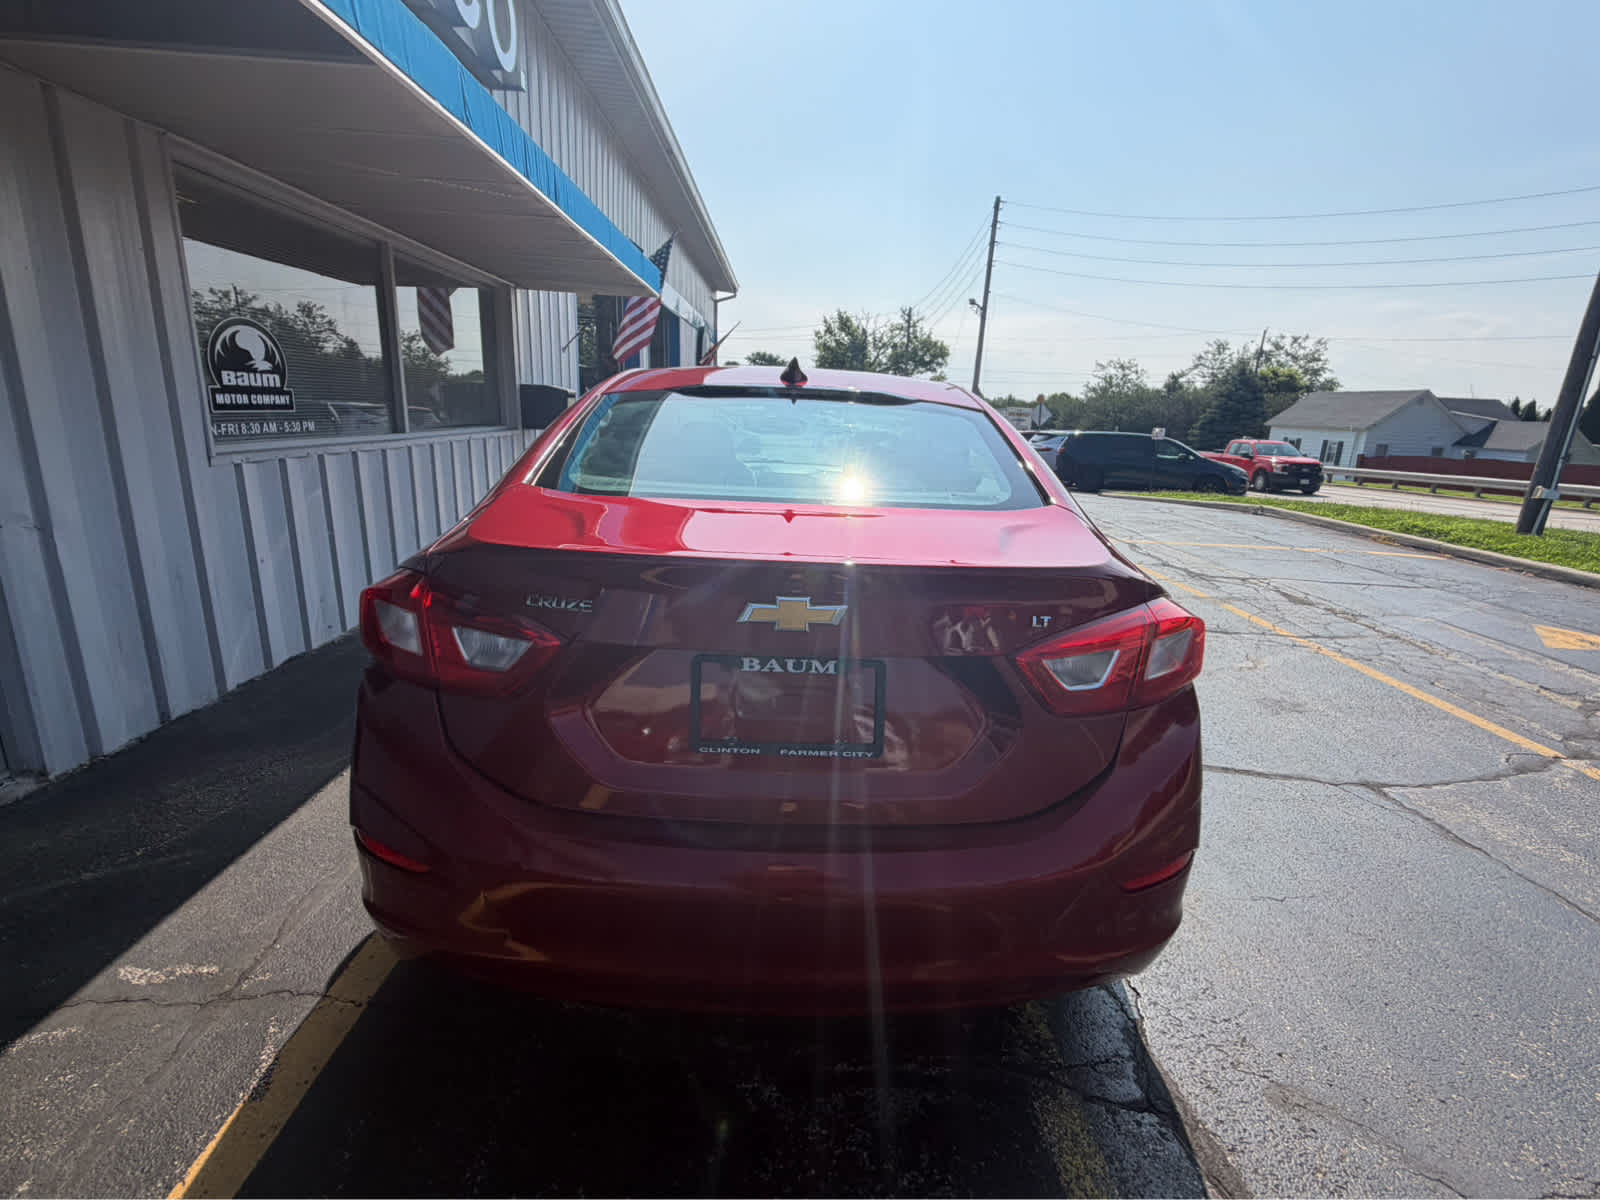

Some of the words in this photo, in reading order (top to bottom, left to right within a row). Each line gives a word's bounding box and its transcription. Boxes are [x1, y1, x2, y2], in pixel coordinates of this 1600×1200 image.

[221, 370, 281, 387] Baum
[215, 393, 249, 405] MOTOR
[250, 394, 290, 405] COMPANY
[240, 423, 261, 435] 8:30
[262, 422, 278, 433] AM
[283, 421, 301, 433] 5:30
[302, 420, 315, 432] PM
[525, 592, 593, 613] CRUZE
[1032, 615, 1052, 628] LT
[740, 656, 838, 675] BAUM
[699, 746, 761, 755] CLINTON
[779, 748, 838, 758] FARMER
[842, 750, 874, 759] CITY
